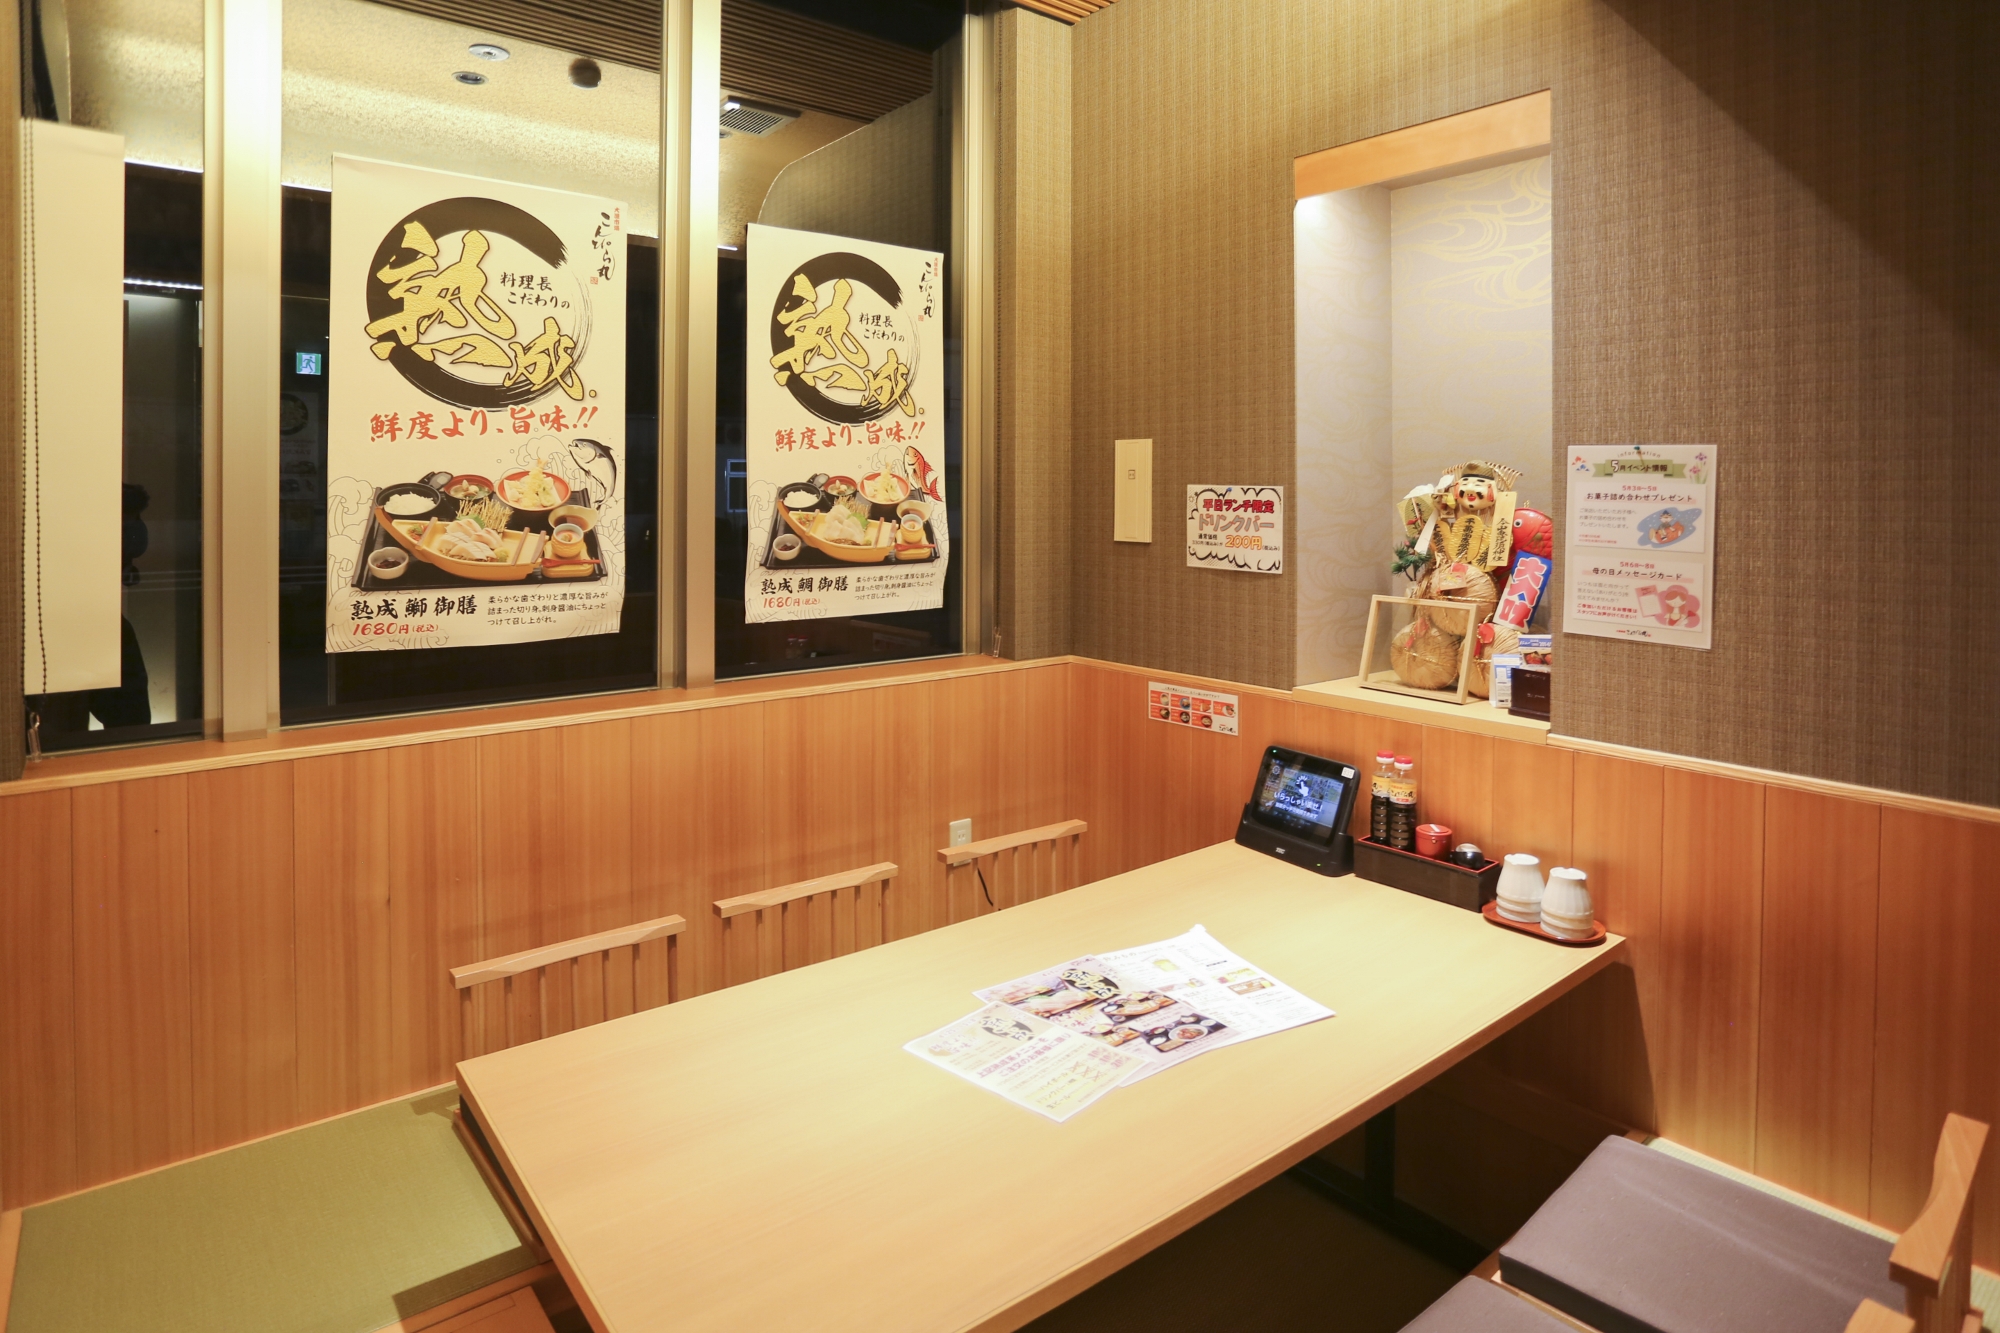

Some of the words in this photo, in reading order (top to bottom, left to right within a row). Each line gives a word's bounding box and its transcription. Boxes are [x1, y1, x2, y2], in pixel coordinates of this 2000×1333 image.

[500, 272, 553, 292] 料理長
[508, 292, 570, 310] こだわりの
[859, 313, 894, 328] 料理長
[863, 328, 905, 342] こだわりの
[1610, 459, 1668, 473] 5月イベント情報
[1586, 492, 1693, 503] お菓子詰め合わせプレゼント
[1203, 498, 1275, 514] 平日ランチ限定
[1198, 513, 1274, 532] ドリンクバー
[1225, 535, 1263, 551] 200円
[1592, 567, 1683, 580] 母の日メッセージカード
[488, 591, 609, 604] 柔らかな歯ざわりと濃厚な旨みが
[487, 616, 557, 626] つけて召し上がれ。
